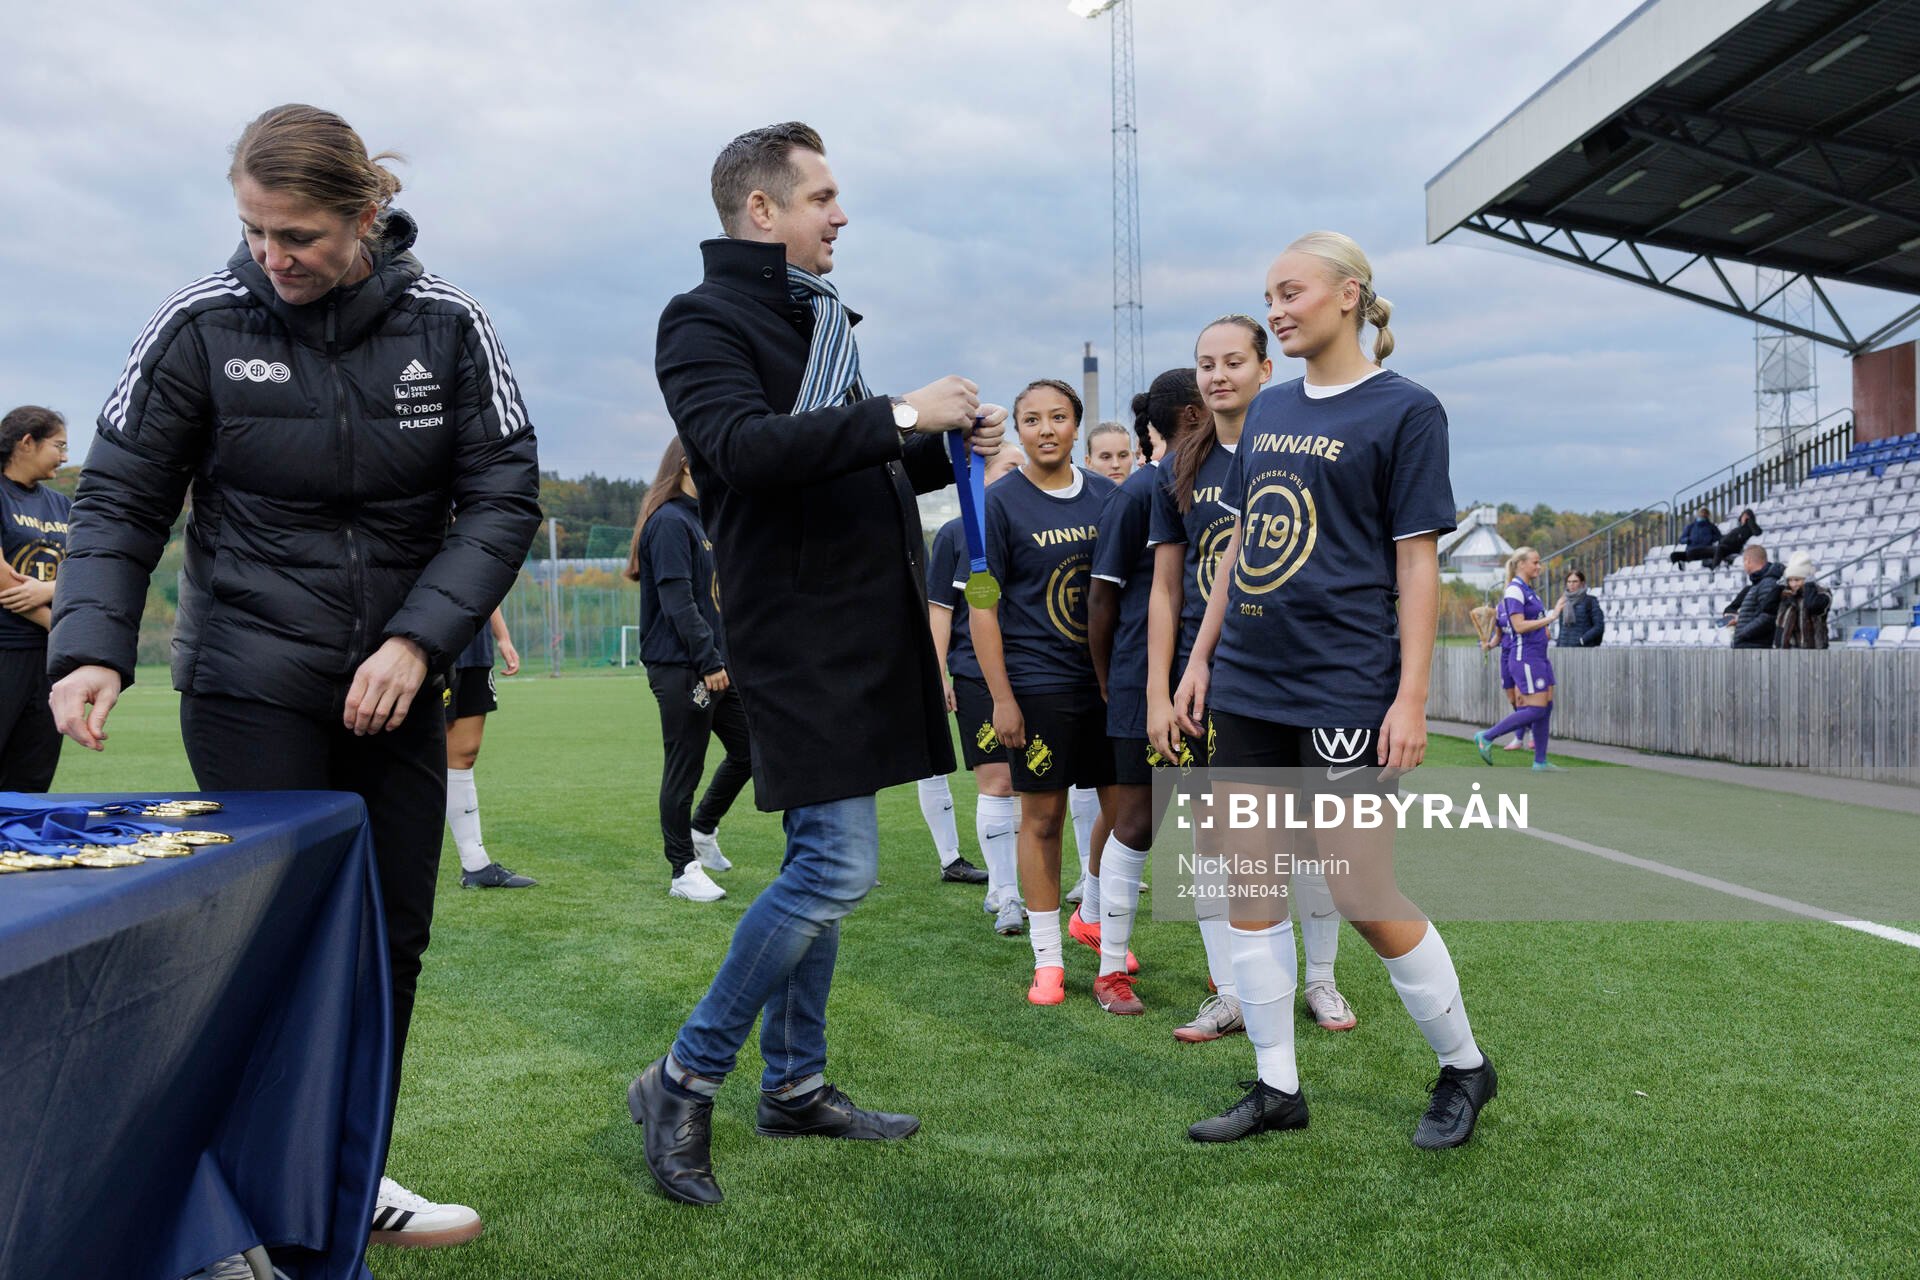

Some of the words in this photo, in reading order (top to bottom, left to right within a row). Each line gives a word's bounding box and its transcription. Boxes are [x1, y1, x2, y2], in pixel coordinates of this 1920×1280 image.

[400, 372, 433, 382] adidas
[410, 384, 441, 392] SVENSKA
[413, 403, 443, 413] OBOS
[399, 416, 443, 430] PULSEN
[1252, 433, 1345, 461] VINNARE
[1252, 470, 1287, 486] SVENSKA
[1289, 472, 1305, 490] SPEL
[1245, 512, 1290, 549] F19
[1240, 603, 1263, 616] 2024
